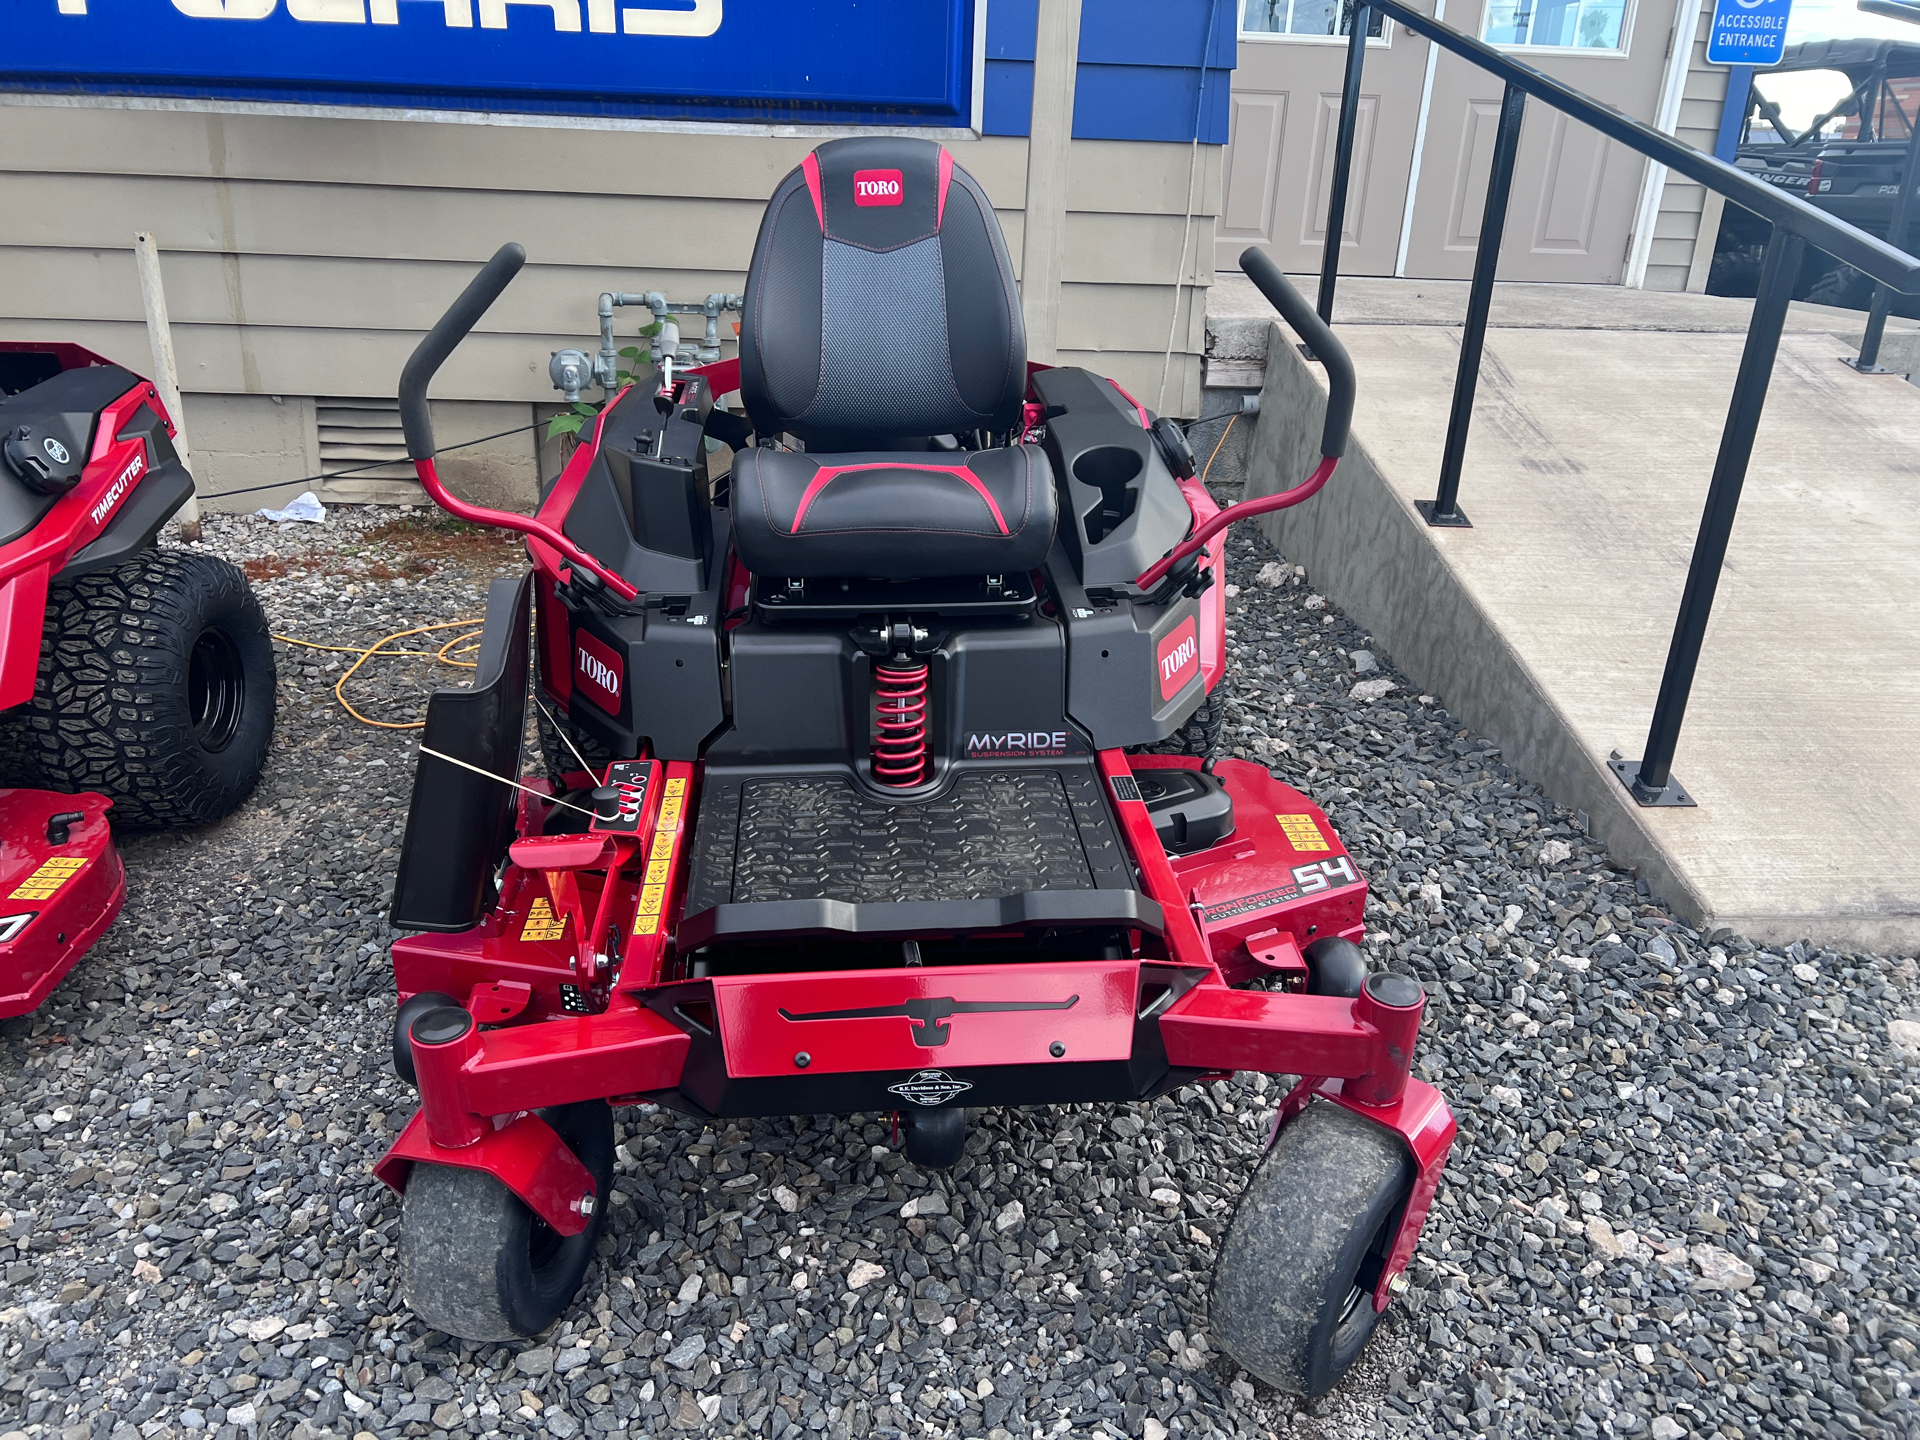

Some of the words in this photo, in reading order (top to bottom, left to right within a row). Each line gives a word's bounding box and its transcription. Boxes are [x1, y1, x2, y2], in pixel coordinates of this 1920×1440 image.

[1718, 14, 1785, 30] ACCESSIBLE
[1718, 33, 1777, 48] ENTRANCE
[857, 180, 899, 196] TORO
[91, 455, 144, 525] TIMECUTTER
[578, 646, 618, 694] TORO
[1161, 636, 1195, 681] TORO
[971, 750, 1026, 758] SUSPENSION
[1292, 856, 1357, 894] 54
[1204, 885, 1298, 917] RONFORGED
[1211, 903, 1257, 920] CUTTING
[1258, 892, 1300, 907] SYSTEM
